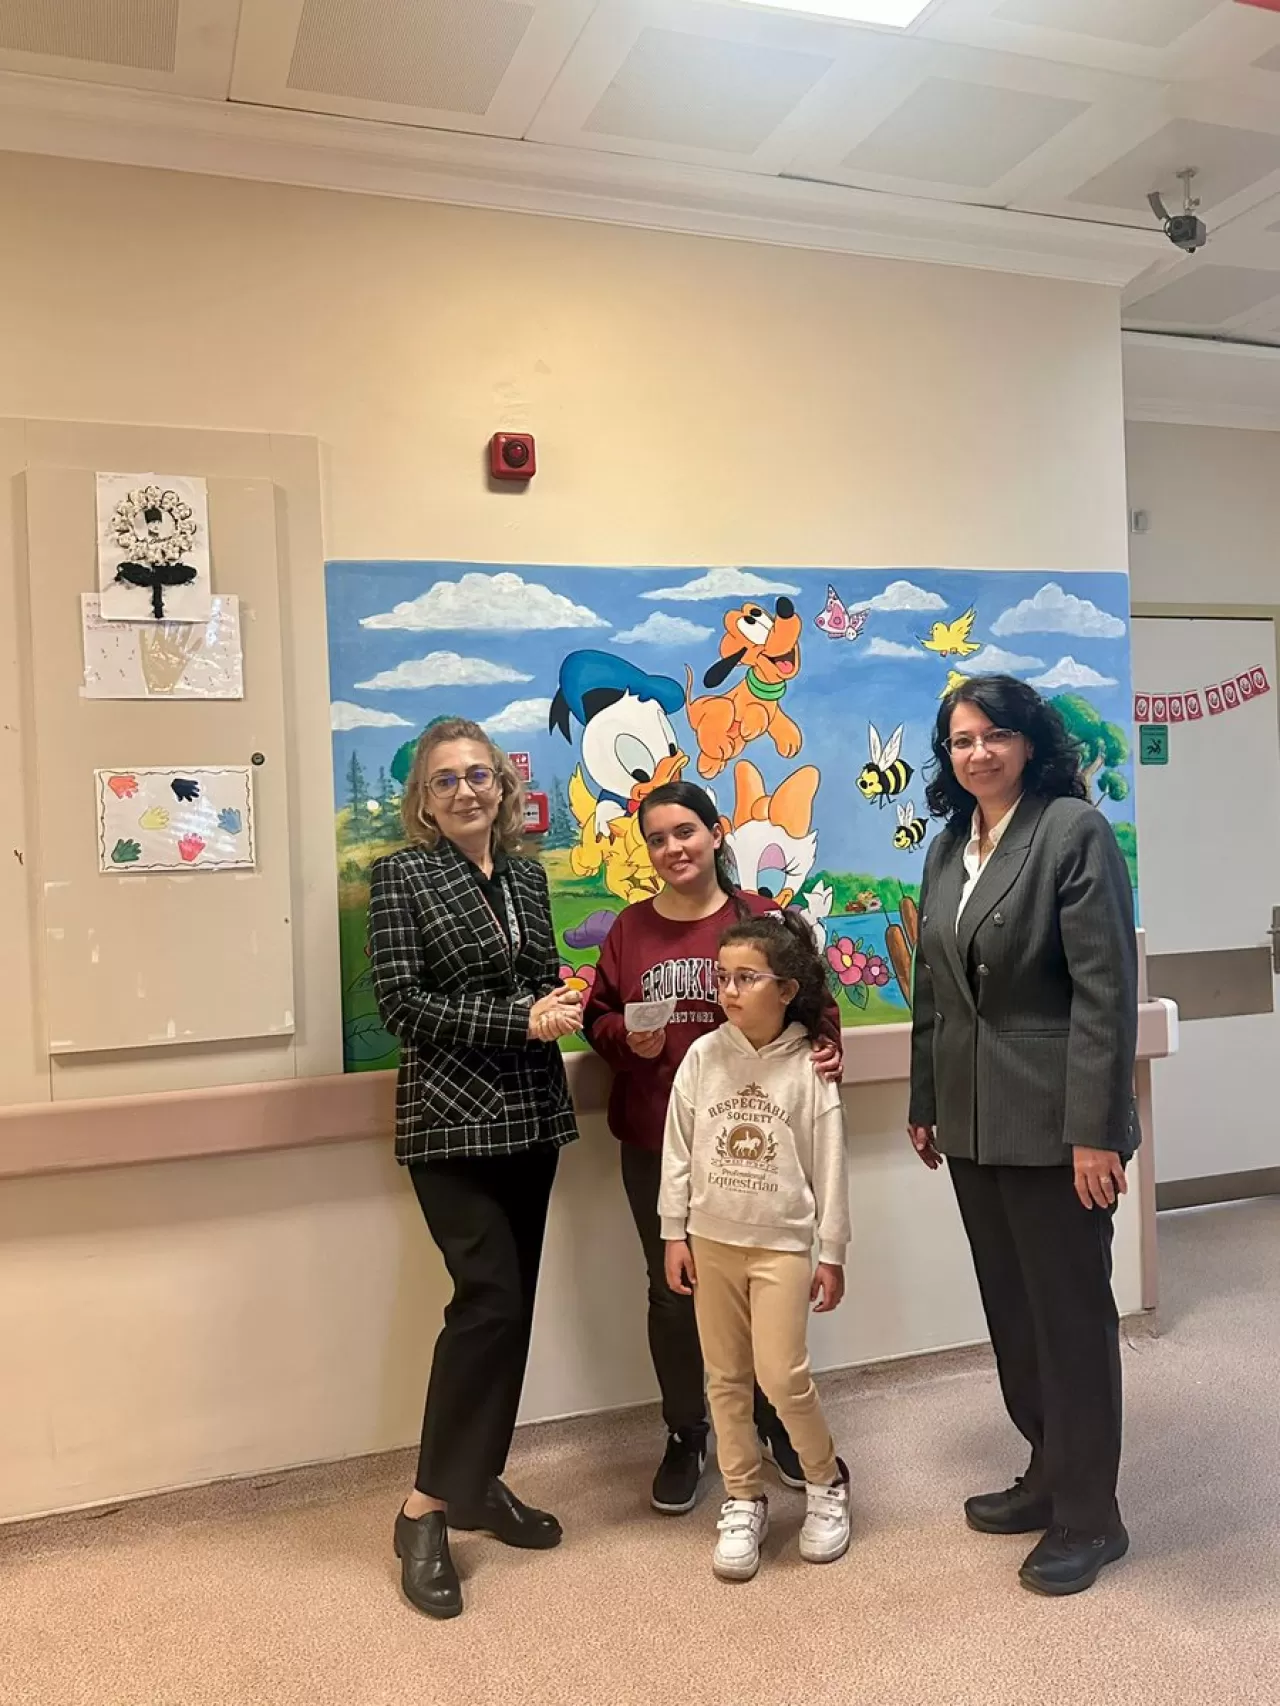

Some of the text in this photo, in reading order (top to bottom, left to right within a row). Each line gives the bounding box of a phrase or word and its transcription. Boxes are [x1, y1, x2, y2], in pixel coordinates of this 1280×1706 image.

[641, 957, 718, 1003] BROOKL
[689, 1011, 715, 1023] YORK
[707, 1097, 793, 1127] RESPECTABLE
[726, 1111, 773, 1124] SOCIETY
[707, 1172, 779, 1192] Equestrian
[722, 1168, 766, 1180] Professional
